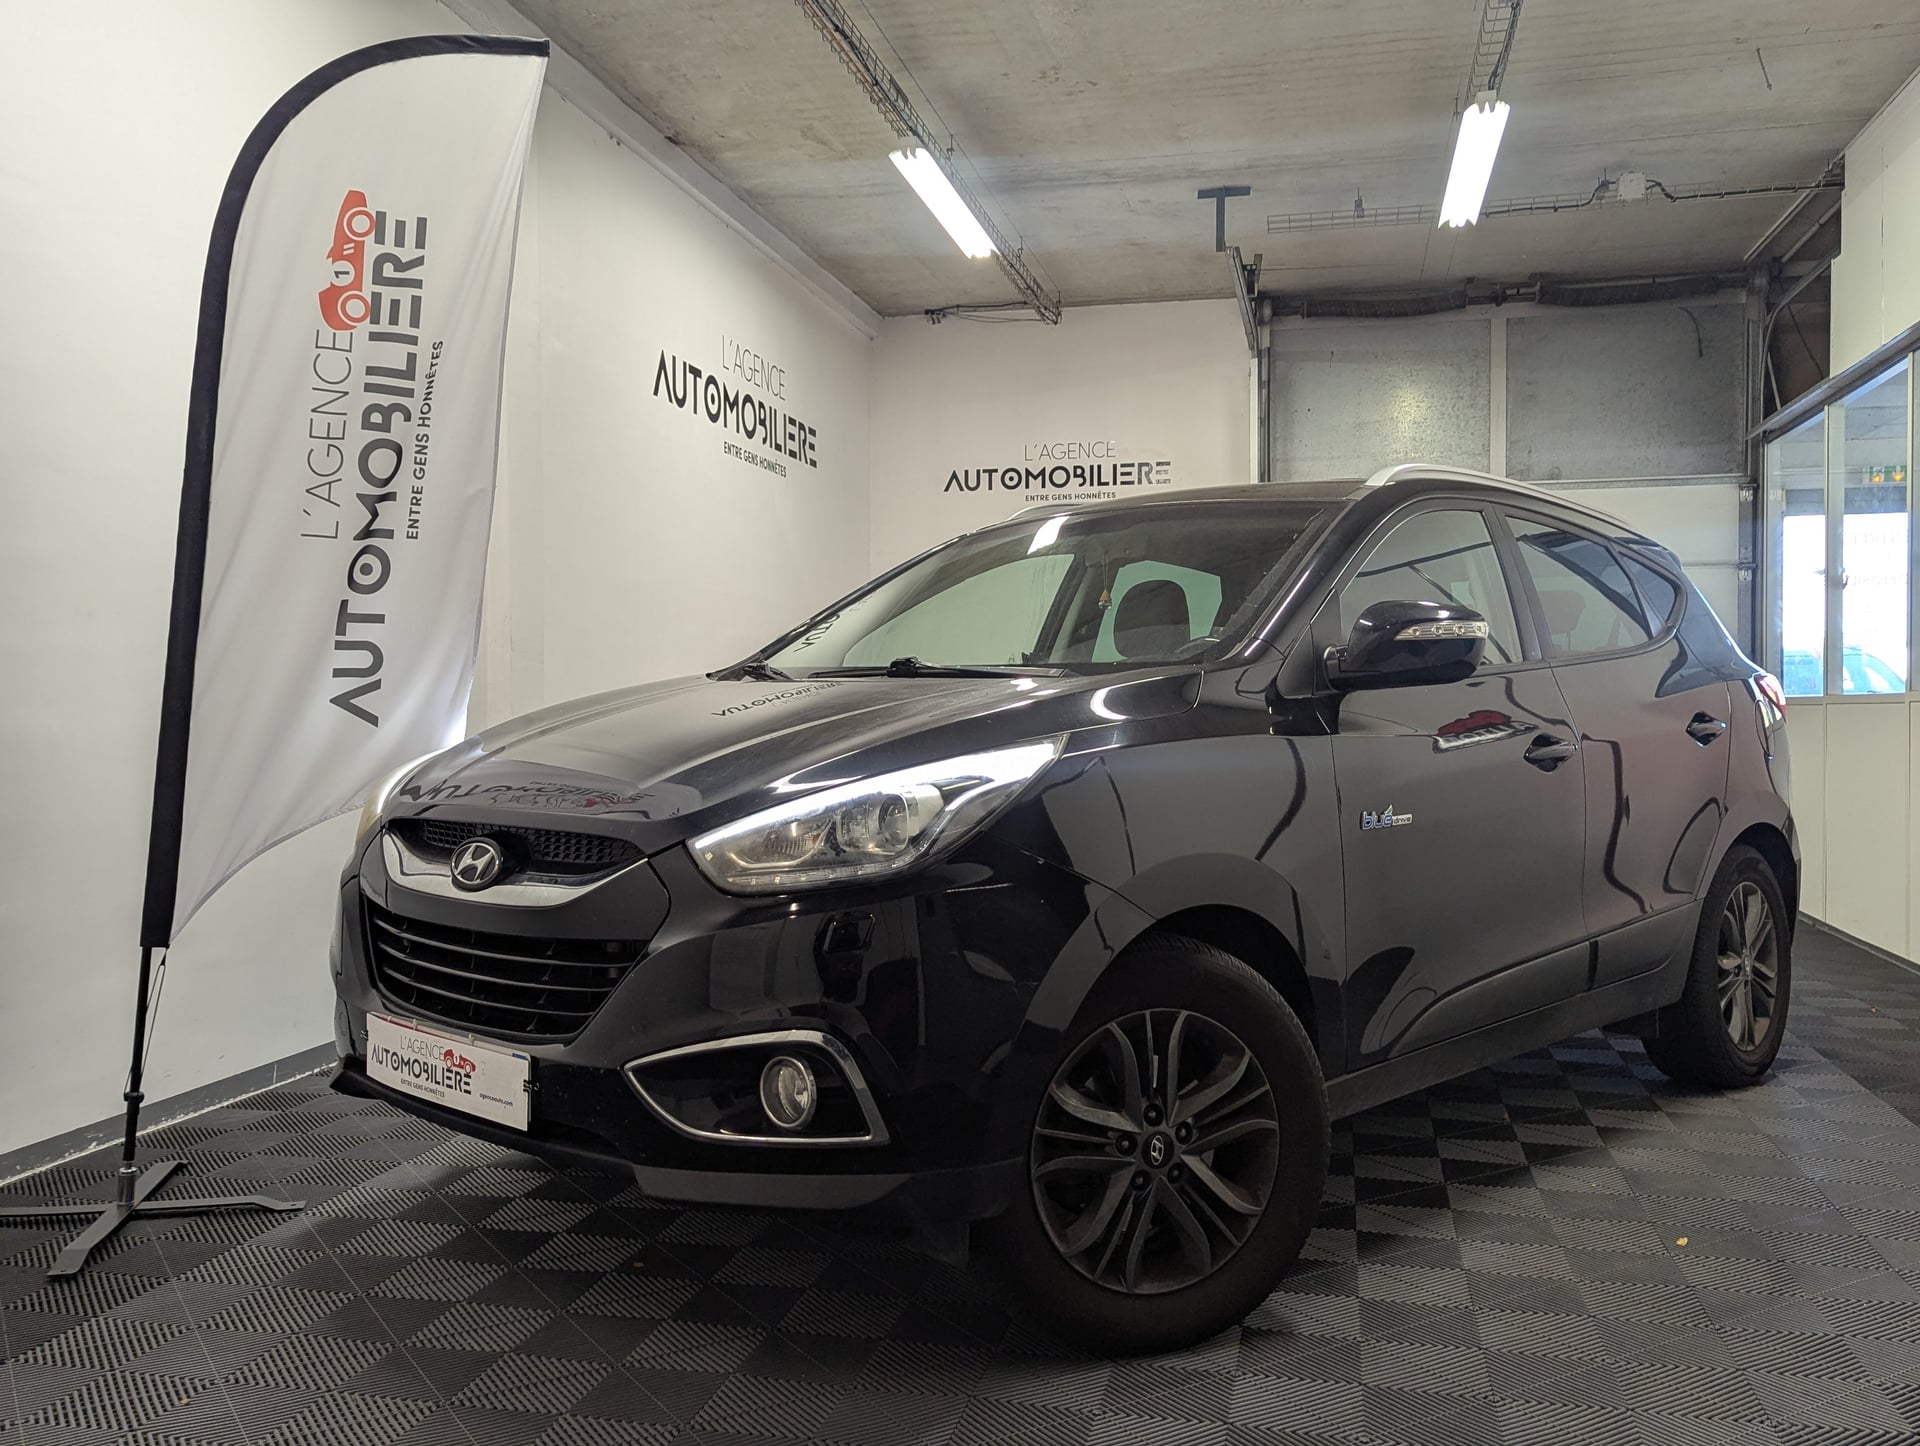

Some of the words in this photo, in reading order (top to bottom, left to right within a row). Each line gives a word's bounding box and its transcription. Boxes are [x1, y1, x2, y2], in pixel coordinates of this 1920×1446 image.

[417, 340, 443, 428] HONNÊTES
[722, 335, 786, 401] L'AGENCE
[301, 328, 353, 539] L'AGENCE
[652, 348, 818, 469] AUTOMOBILIERE
[328, 210, 428, 728] AUTOMOBILIERE
[413, 433, 430, 480] GENS
[723, 441, 743, 460] ENTRE
[743, 449, 759, 467] GENS
[943, 460, 1172, 493] AUTOMOBILIERE
[1024, 440, 1117, 462] L'AGENCE
[406, 485, 424, 540] ENTRE
[1025, 494, 1050, 502] ENTRE
[1051, 493, 1073, 501] GENS
[1074, 490, 1117, 500] HONNÊTES
[371, 1043, 472, 1095] AUTOMOBILIERE
[400, 1035, 445, 1062] L'AGENCE
